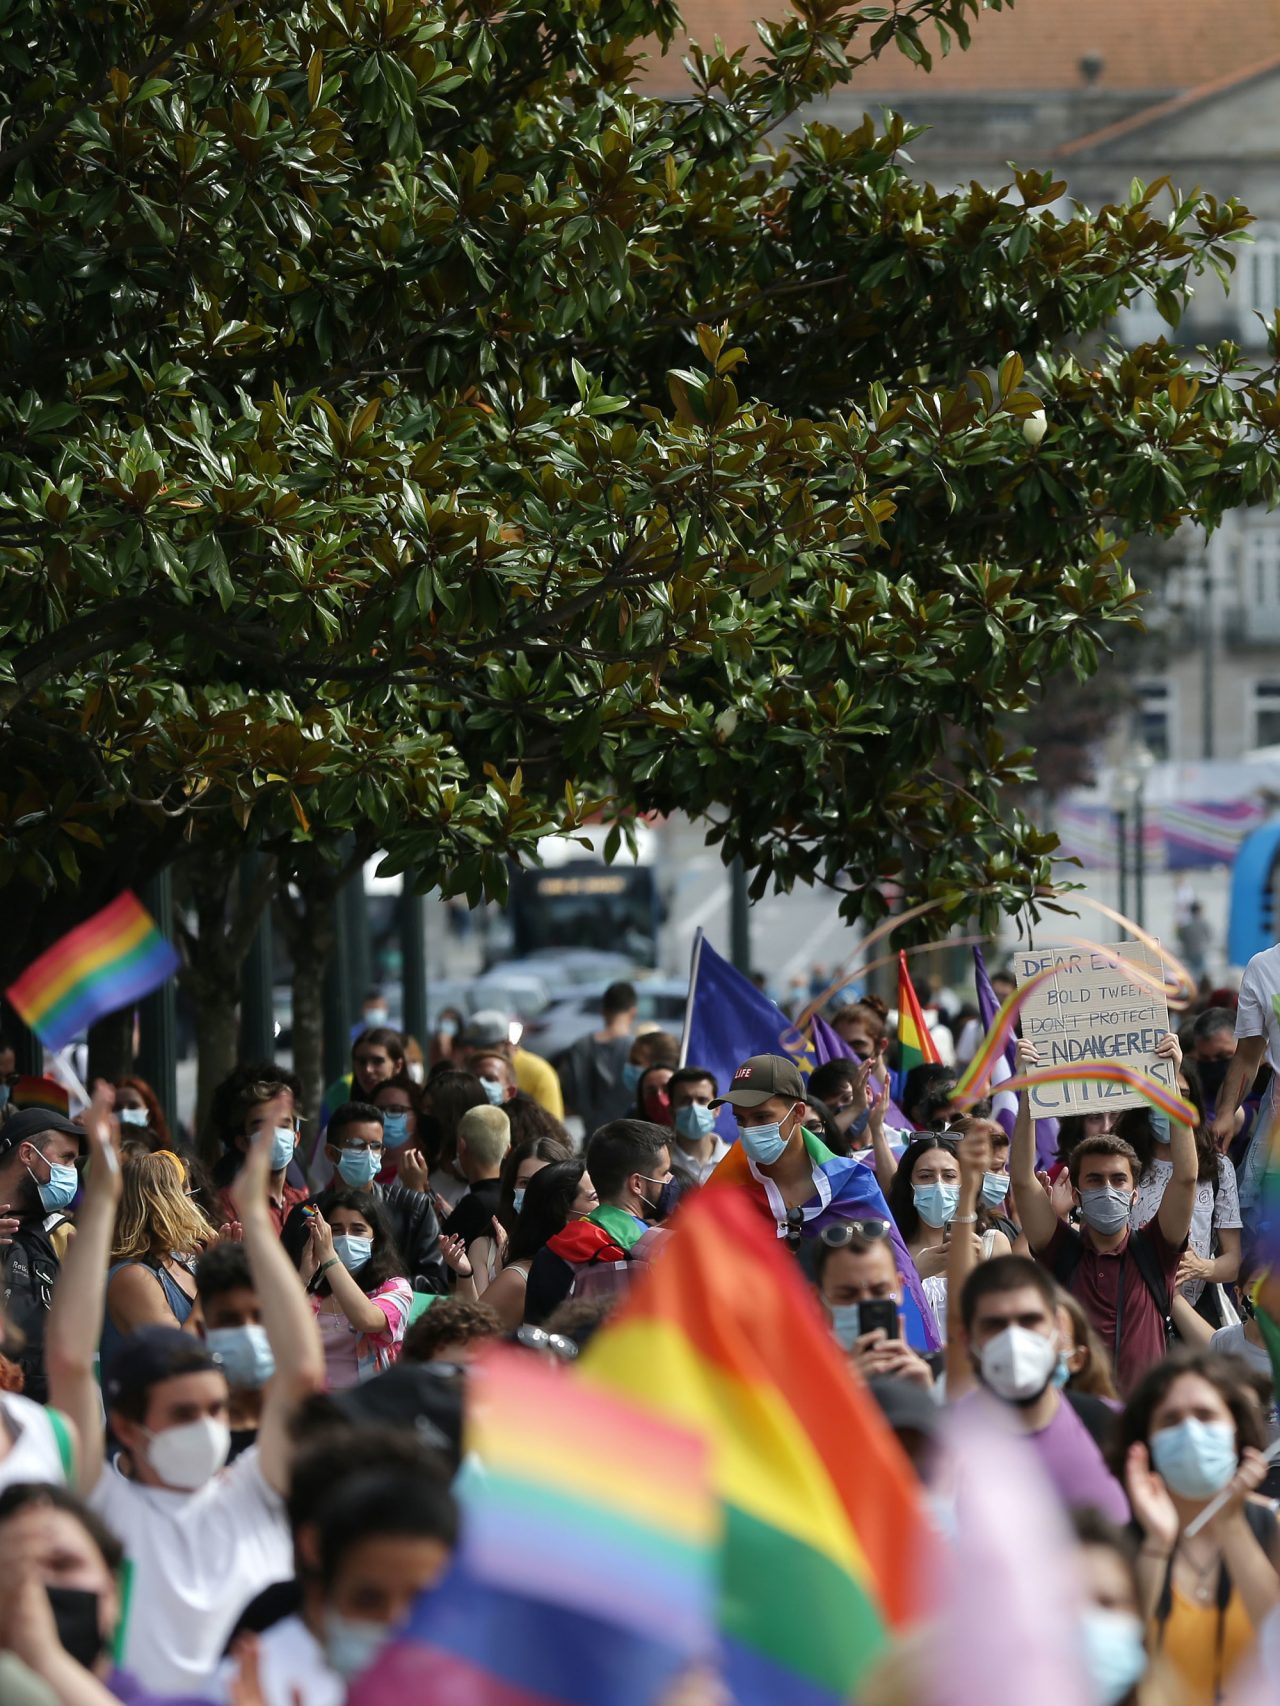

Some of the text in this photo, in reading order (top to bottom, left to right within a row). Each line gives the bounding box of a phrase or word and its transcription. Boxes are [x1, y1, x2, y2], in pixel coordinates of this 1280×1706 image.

[1022, 954, 1082, 977] DEAR
[1047, 984, 1154, 1006] BOLD TWEETS
[1030, 1007, 1158, 1033] DON'T PROTECT
[1032, 1028, 1168, 1068] ENDANGERED
[734, 1068, 752, 1079] LIFE
